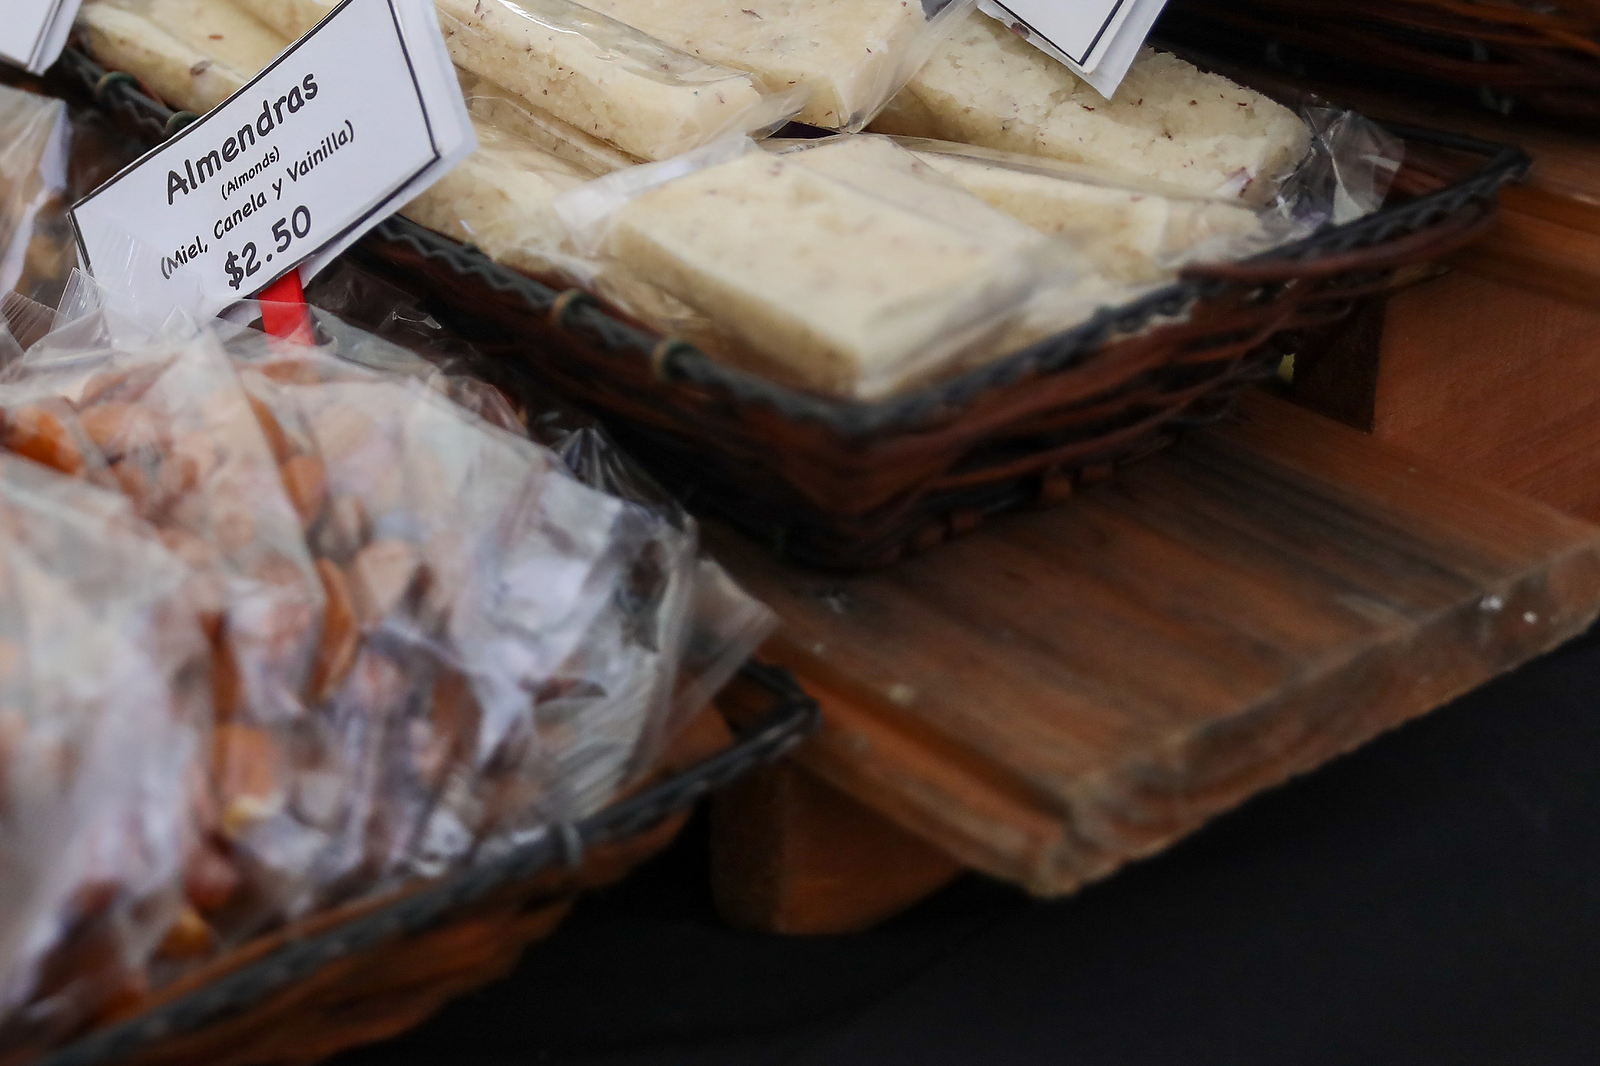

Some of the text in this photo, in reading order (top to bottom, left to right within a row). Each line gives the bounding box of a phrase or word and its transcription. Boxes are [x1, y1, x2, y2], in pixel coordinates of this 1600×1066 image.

[166, 72, 318, 205] Almendras
[221, 145, 280, 201] (Almonds)
[160, 119, 355, 279] (Miel, Canela y Vainilla)
[224, 205, 312, 290] $2.50
